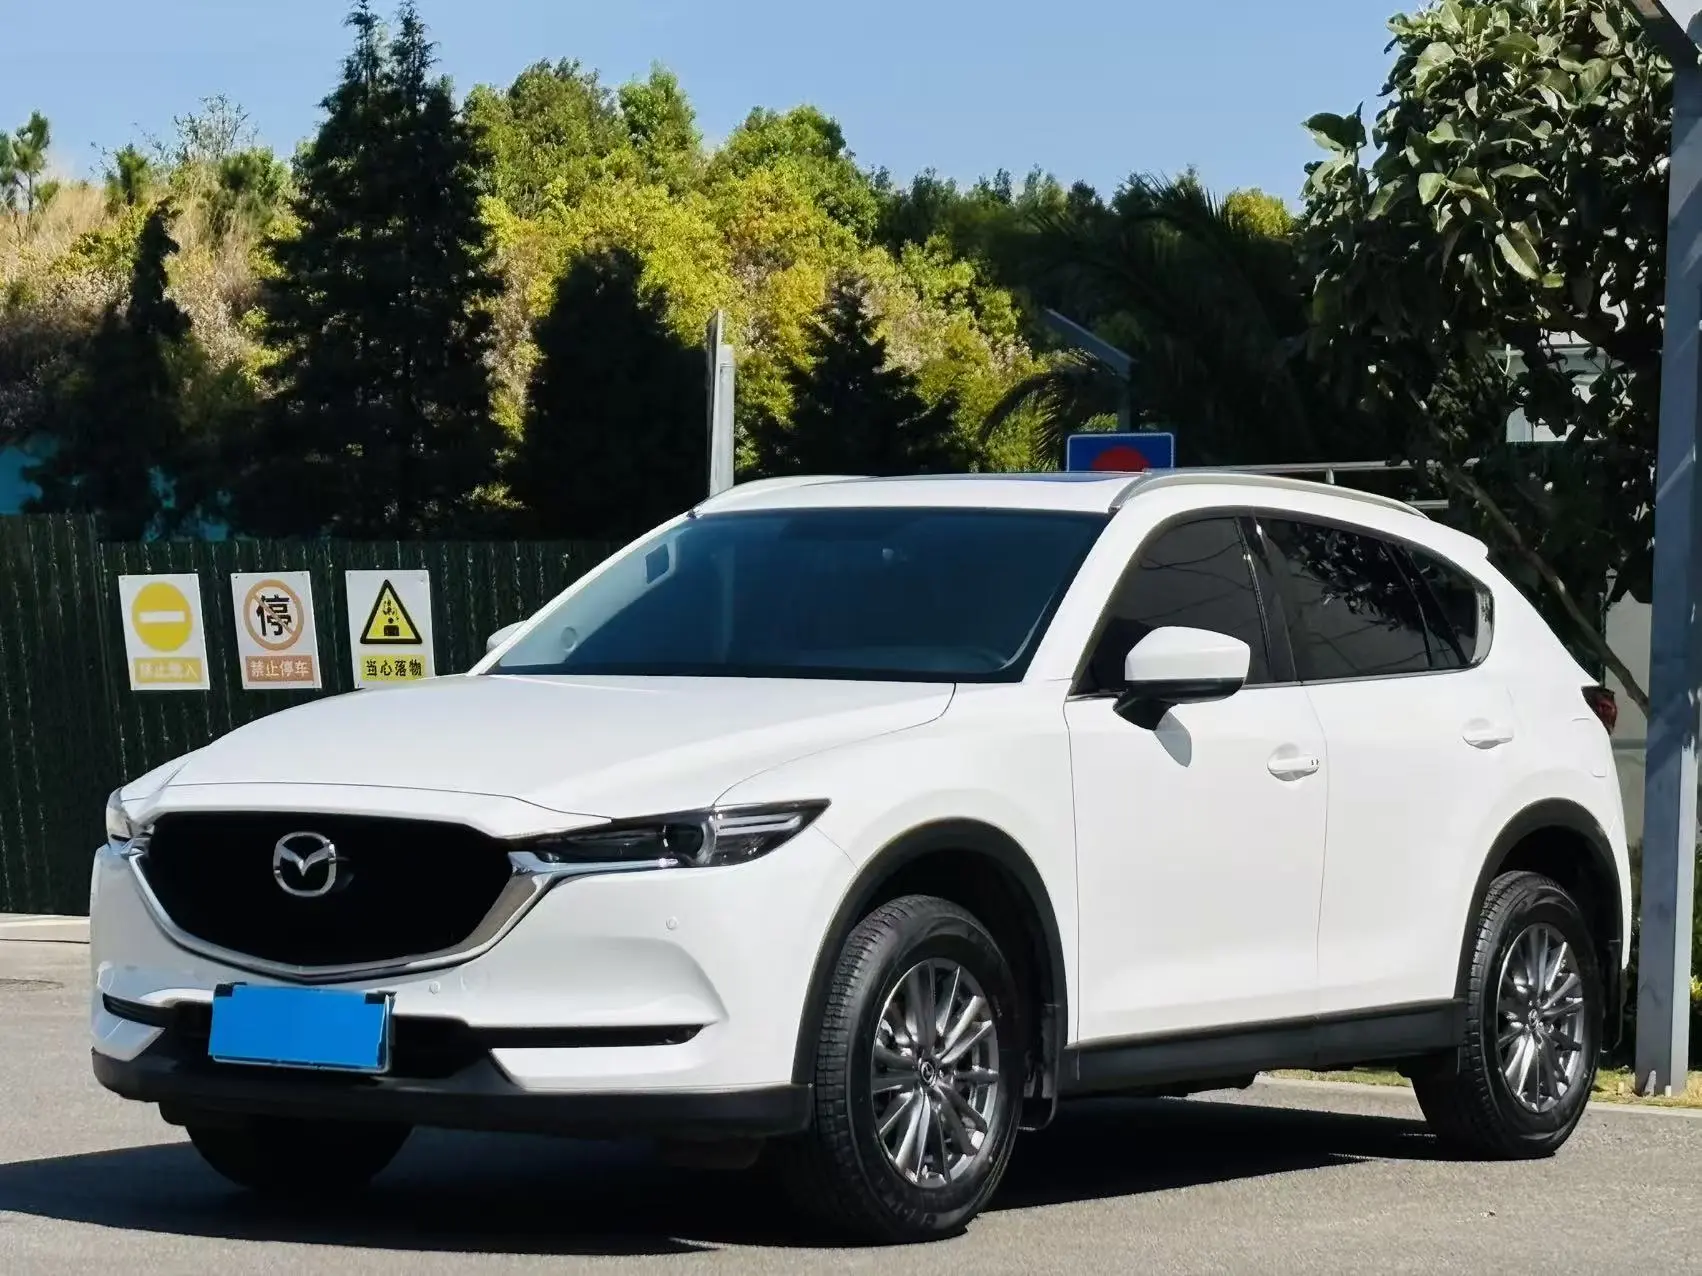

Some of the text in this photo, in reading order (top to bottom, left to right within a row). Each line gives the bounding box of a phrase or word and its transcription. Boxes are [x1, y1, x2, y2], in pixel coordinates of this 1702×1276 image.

[256, 594, 292, 636] 停
[250, 660, 309, 678] 禁止停车
[366, 659, 422, 677] 当心落物
